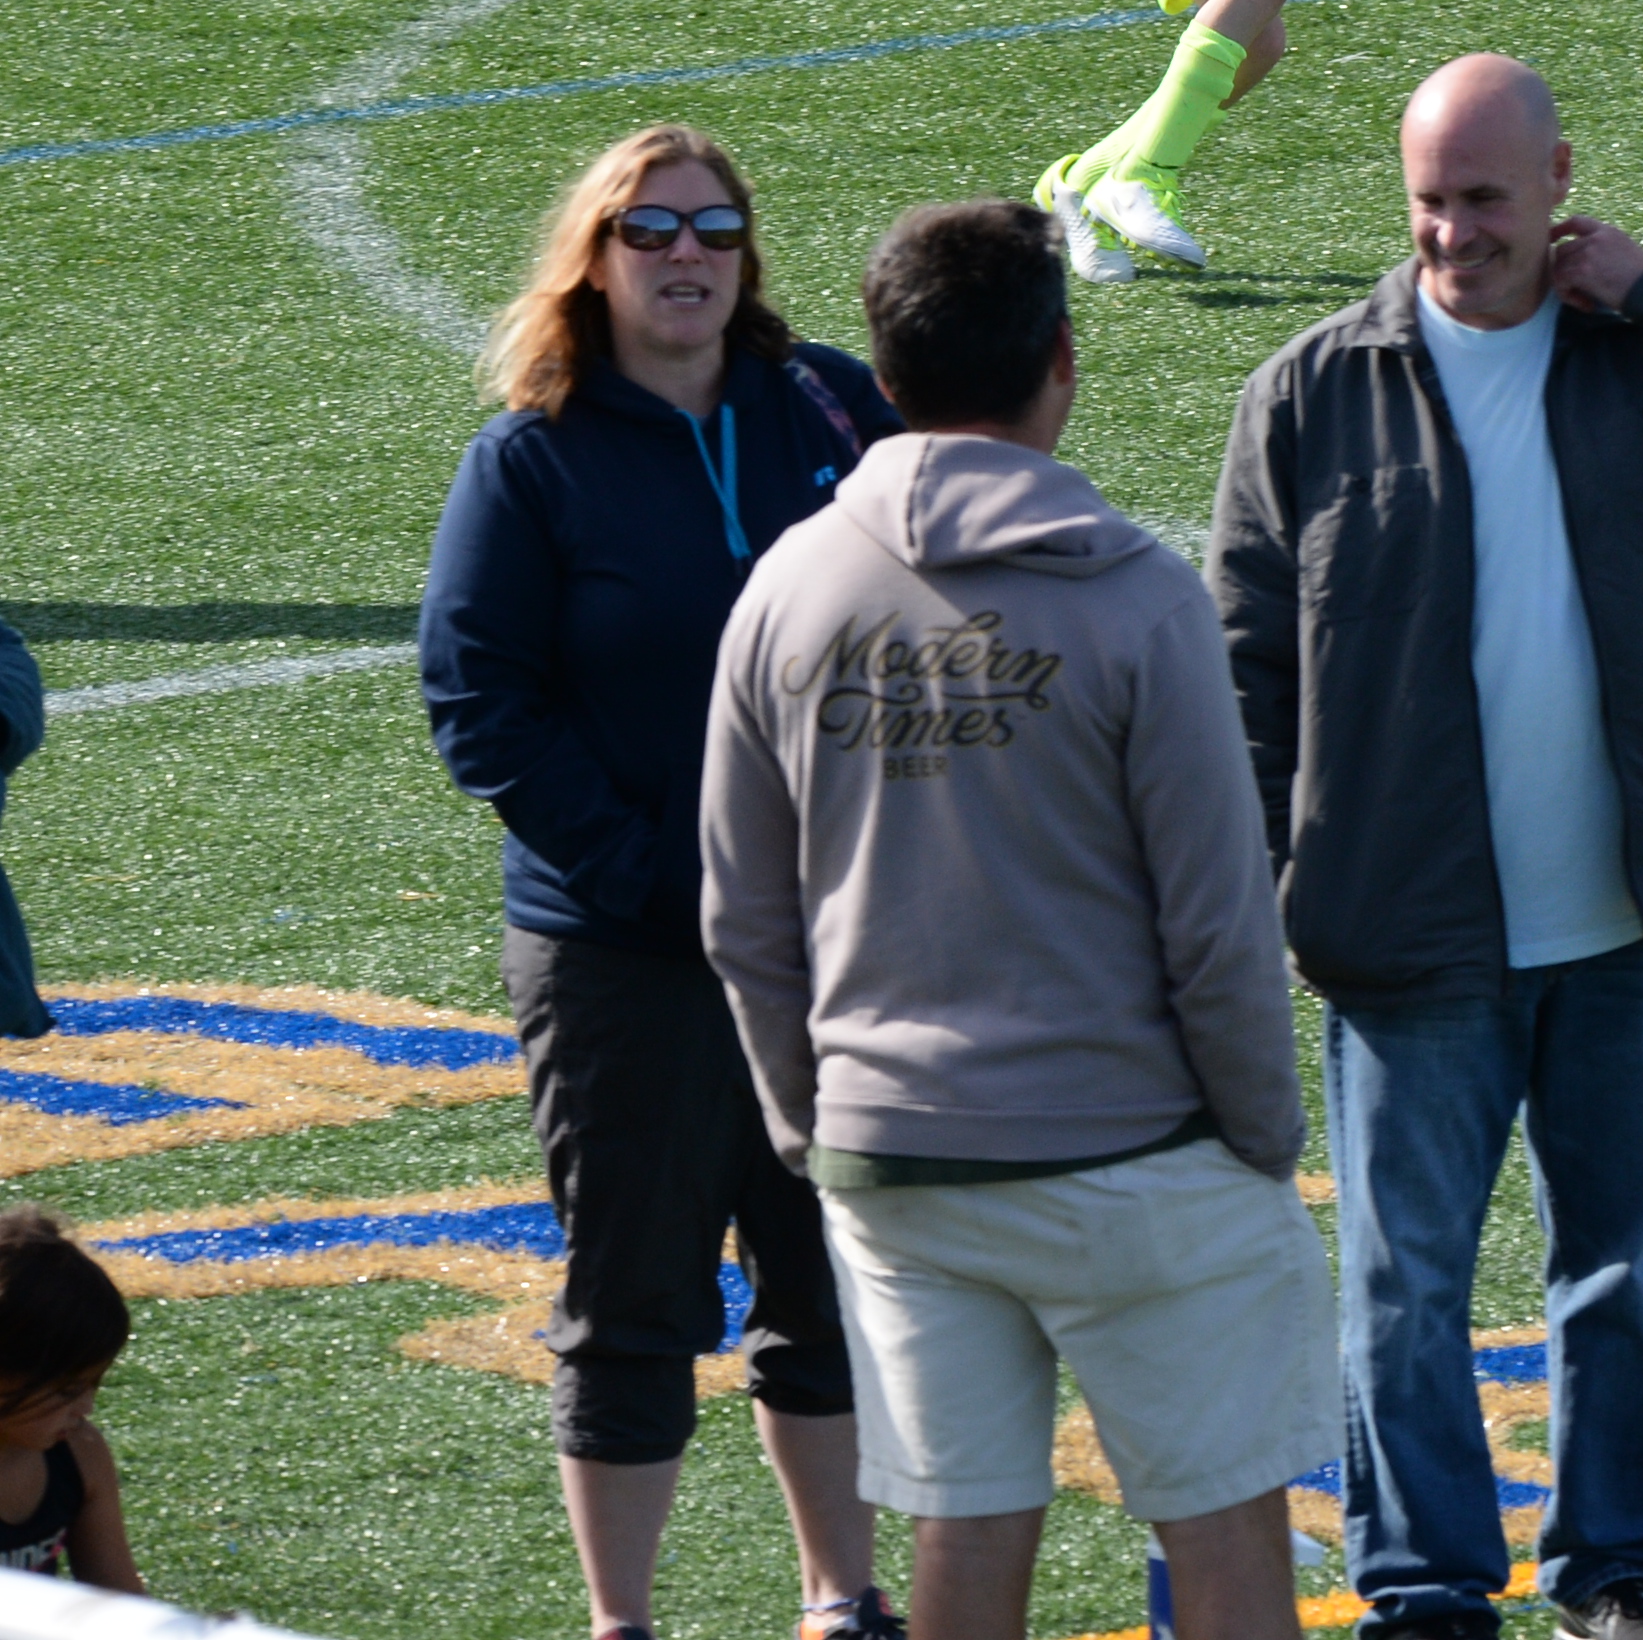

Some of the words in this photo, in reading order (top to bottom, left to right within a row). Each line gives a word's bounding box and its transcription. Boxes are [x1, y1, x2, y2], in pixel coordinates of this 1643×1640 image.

[781, 610, 1064, 712] Modern
[816, 687, 1015, 752] Times
[883, 755, 947, 780] BEER
